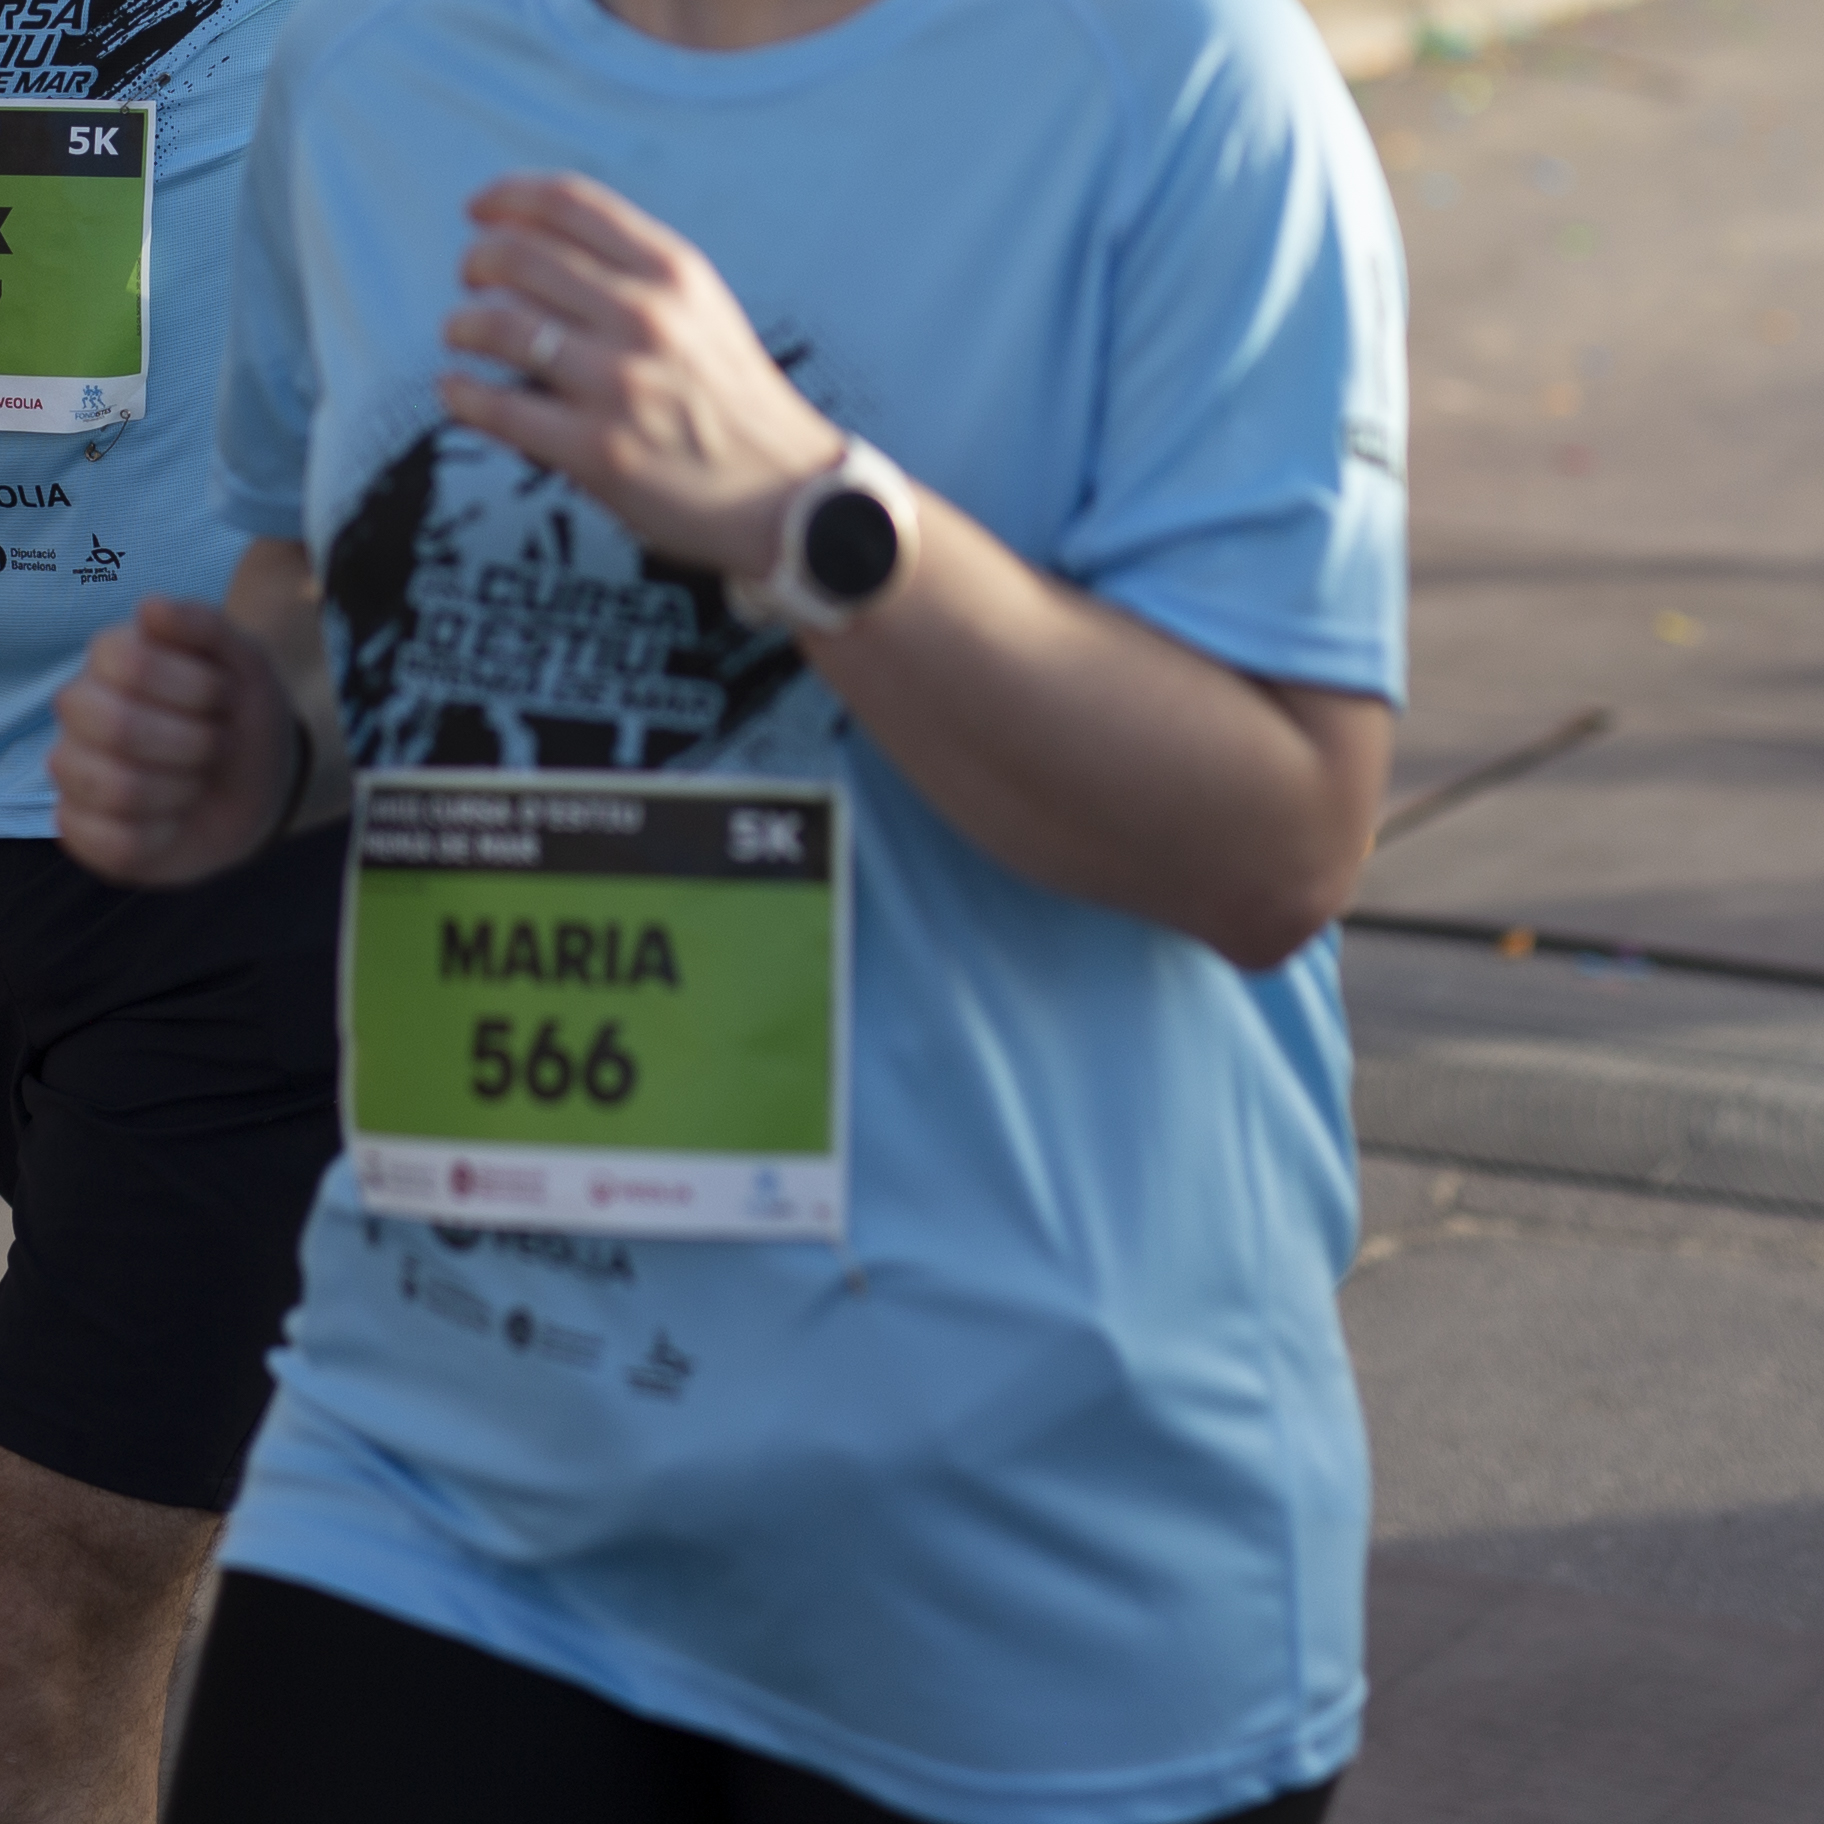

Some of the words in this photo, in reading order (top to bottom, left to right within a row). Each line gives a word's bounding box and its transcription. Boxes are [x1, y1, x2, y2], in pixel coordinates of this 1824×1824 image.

[13, 70, 92, 94] MAR
[68, 126, 119, 156] 5K
[10, 547, 57, 561] Diputació
[11, 560, 57, 572] Barcelona
[726, 810, 805, 863] 5K
[439, 916, 682, 992] MARIA
[469, 1014, 643, 1107] 566
